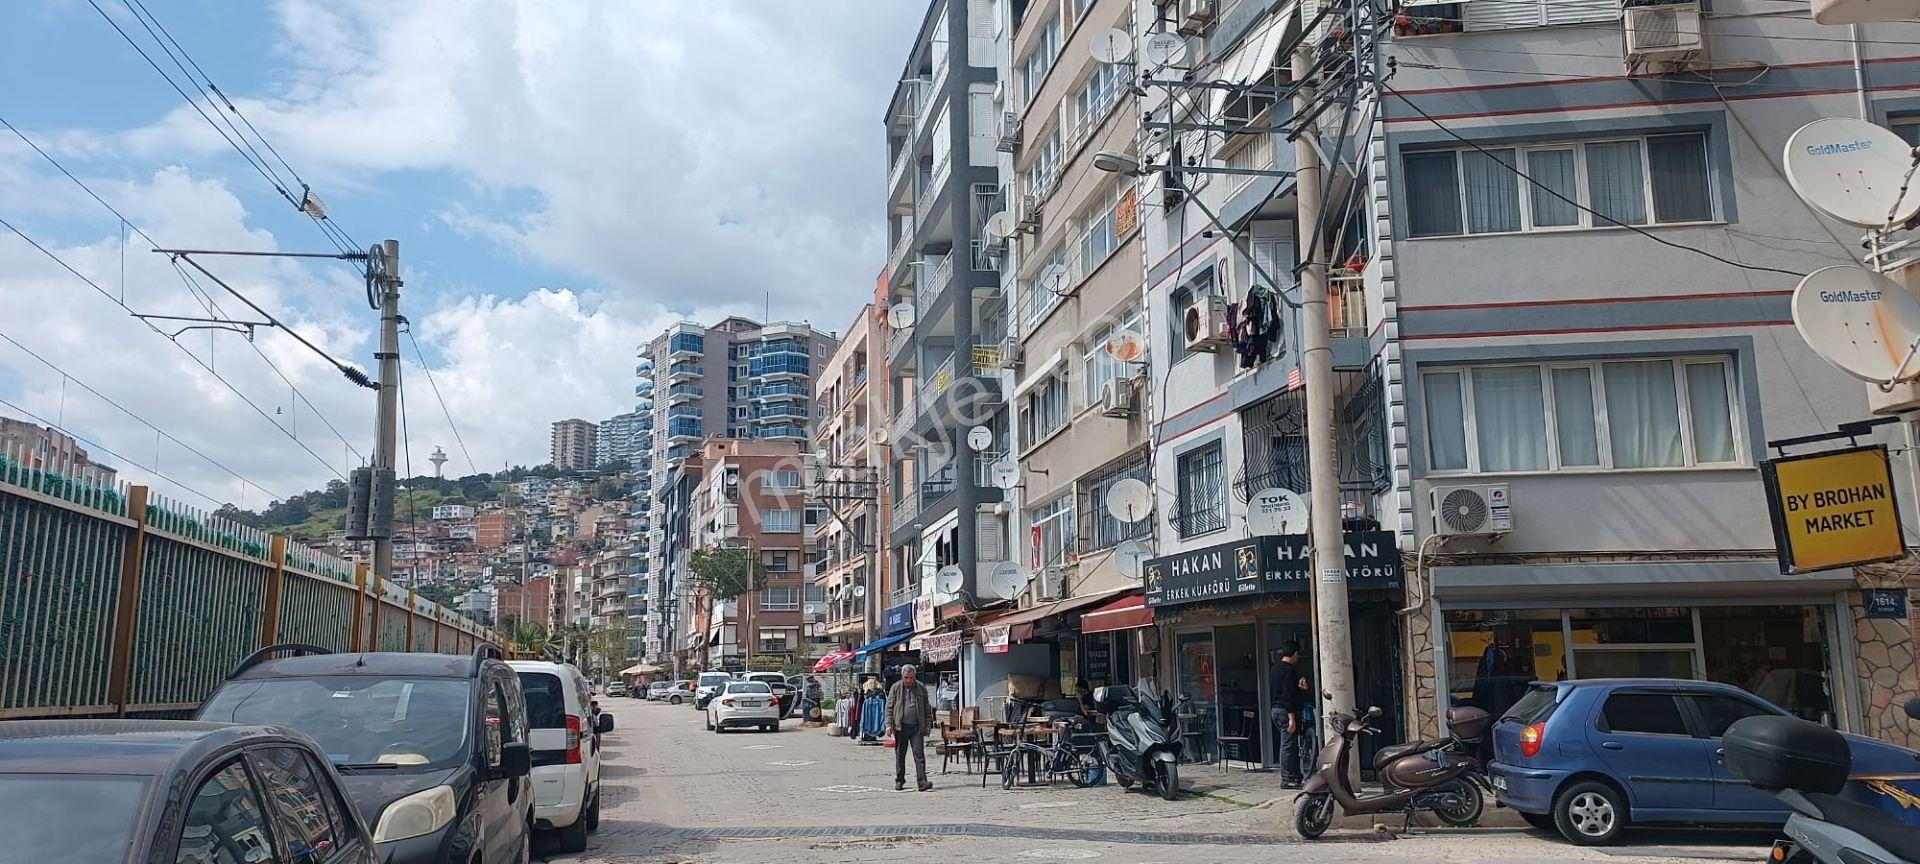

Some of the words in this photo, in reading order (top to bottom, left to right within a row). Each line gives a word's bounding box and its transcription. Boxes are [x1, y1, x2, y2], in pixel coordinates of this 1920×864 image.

[1806, 139, 1872, 157] GoldMaster
[1819, 290, 1883, 303] GoldMaster
[1260, 495, 1289, 505] TOK
[1787, 495, 1808, 512] BY
[1814, 483, 1885, 508] BROHAN
[1805, 509, 1875, 534] MARKET
[1277, 542, 1378, 560] HAAN
[1171, 551, 1222, 577] HAKAN
[1265, 570, 1311, 581] ERKEK
[1166, 588, 1191, 601] ERKEK
[1192, 578, 1231, 597] KUAFÖRÜ
